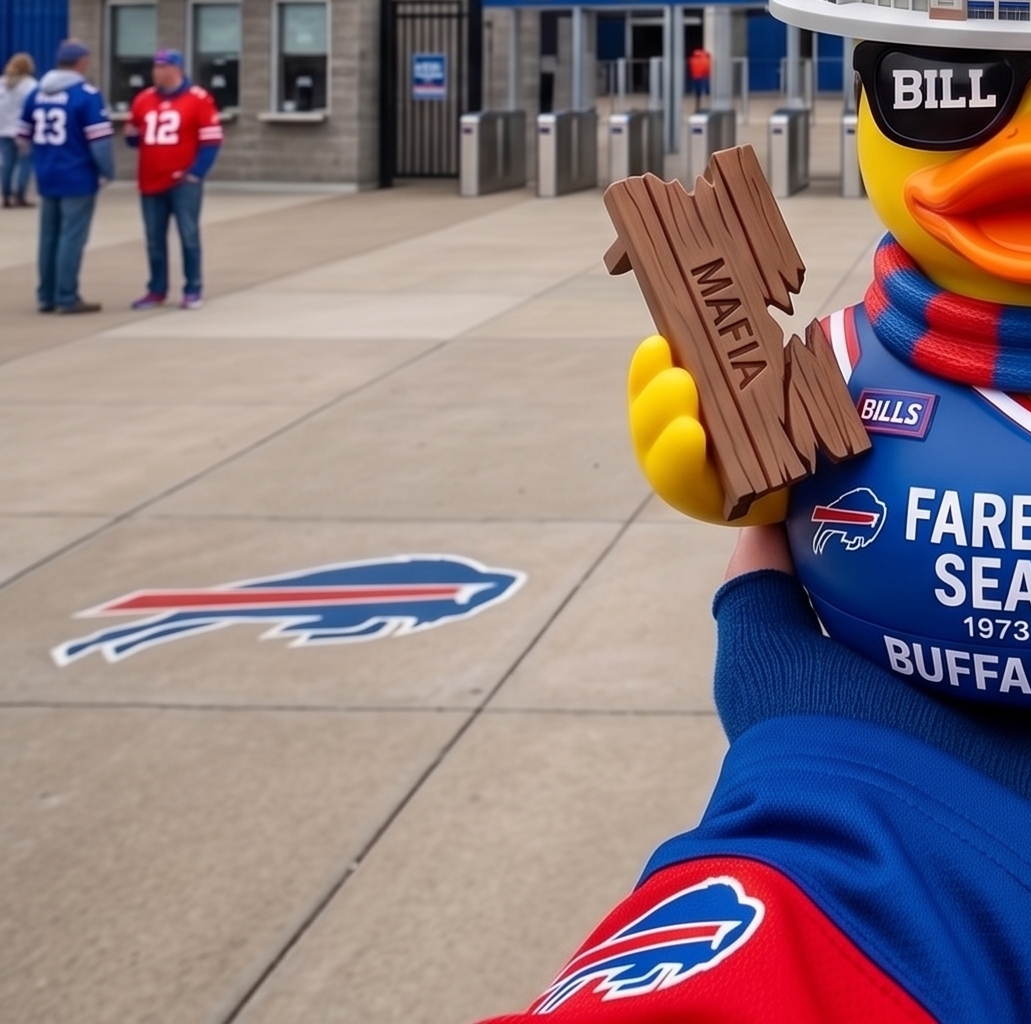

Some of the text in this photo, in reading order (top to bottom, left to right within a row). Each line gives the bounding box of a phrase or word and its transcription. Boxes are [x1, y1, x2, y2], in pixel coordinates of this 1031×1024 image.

[892, 68, 997, 110] BILL
[31, 107, 68, 146] 13
[143, 109, 182, 145] 12
[690, 256, 769, 391] MAFIA
[859, 397, 923, 427] BILLS
[962, 616, 1030, 642] 1973
